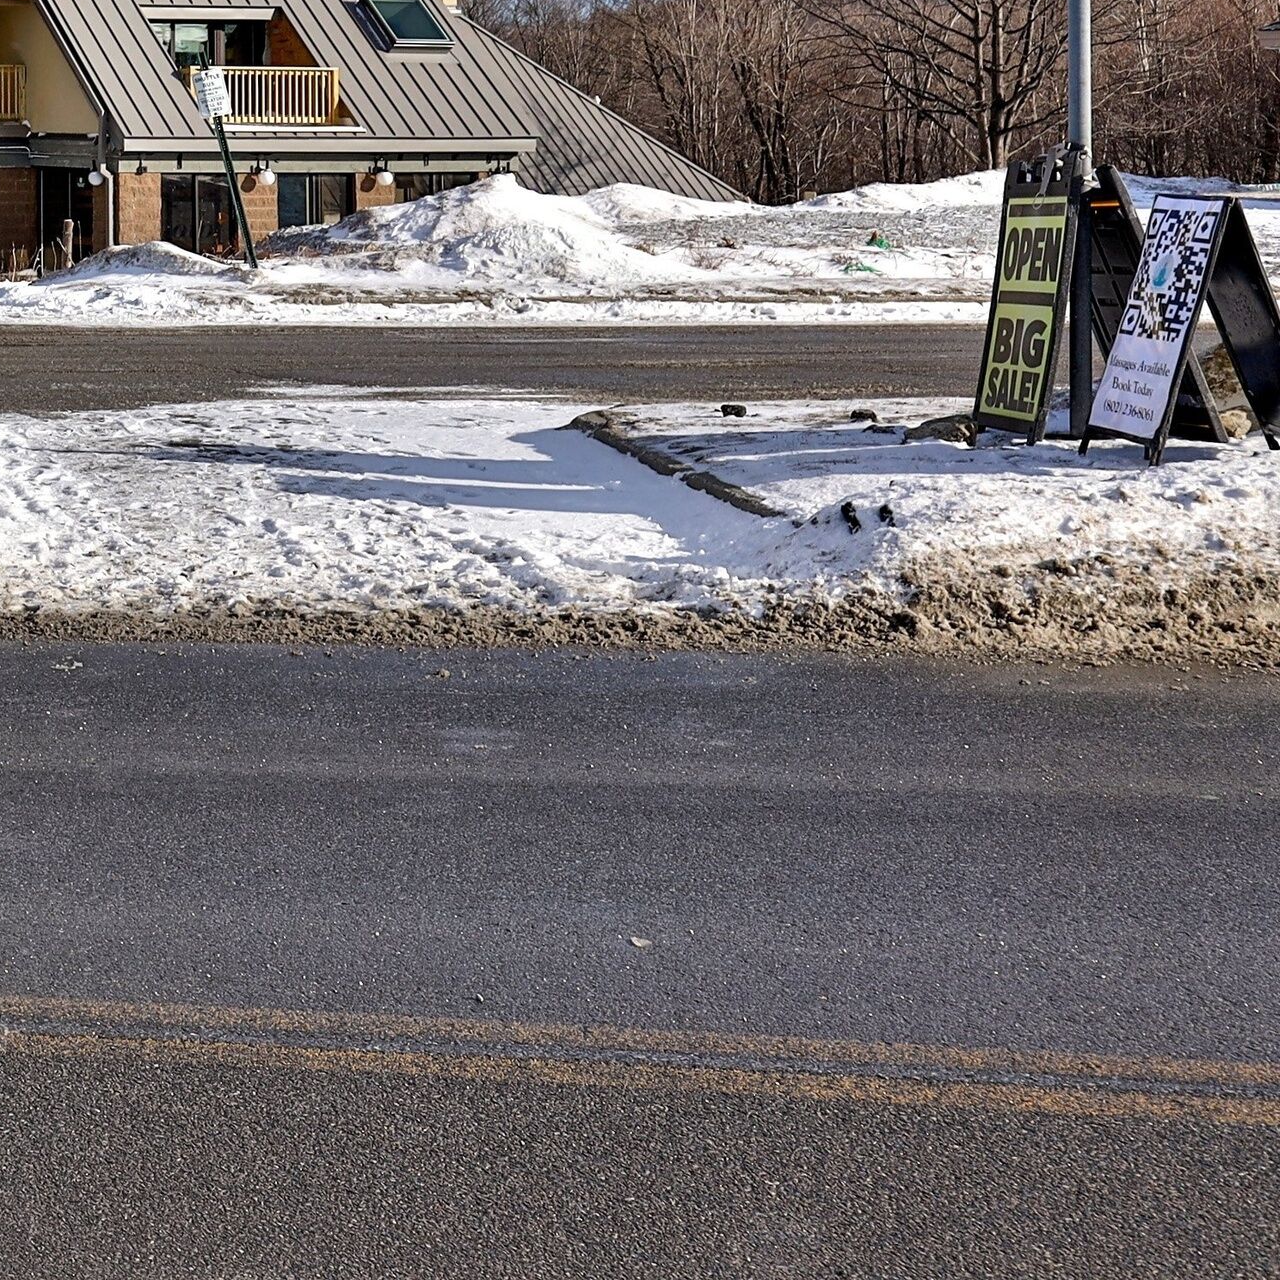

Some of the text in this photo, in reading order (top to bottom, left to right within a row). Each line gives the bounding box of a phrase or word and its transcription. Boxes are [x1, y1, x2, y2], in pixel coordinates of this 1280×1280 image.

[1003, 227, 1062, 282] OPEN
[992, 318, 1048, 369] BIG
[985, 367, 1040, 413] SALE!
[1112, 376, 1154, 400] Book Today
[1137, 360, 1171, 377] Available
